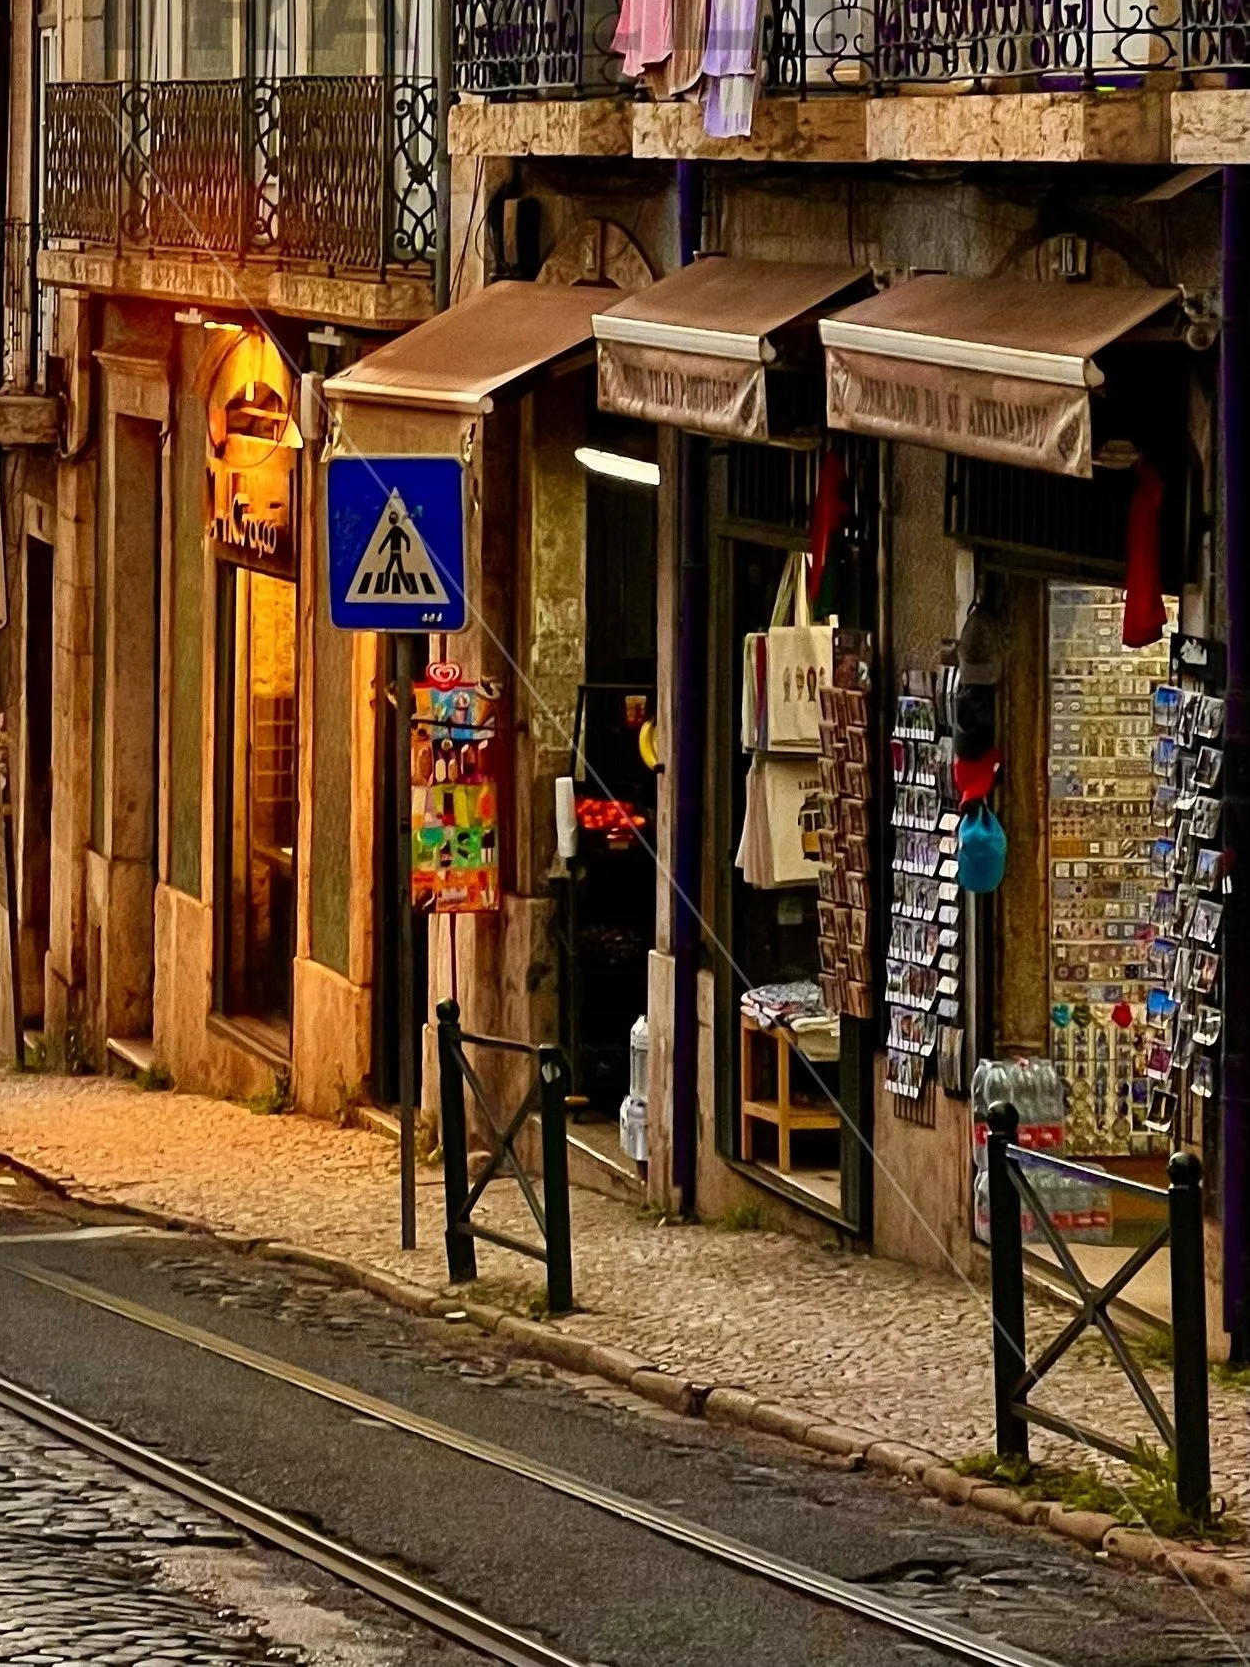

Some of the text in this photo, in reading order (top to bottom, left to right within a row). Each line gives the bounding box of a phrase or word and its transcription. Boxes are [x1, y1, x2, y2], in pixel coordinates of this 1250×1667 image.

[924, 387, 941, 429] DA
[947, 383, 962, 433] SÉ
[967, 397, 1049, 450] ARTESANATO
